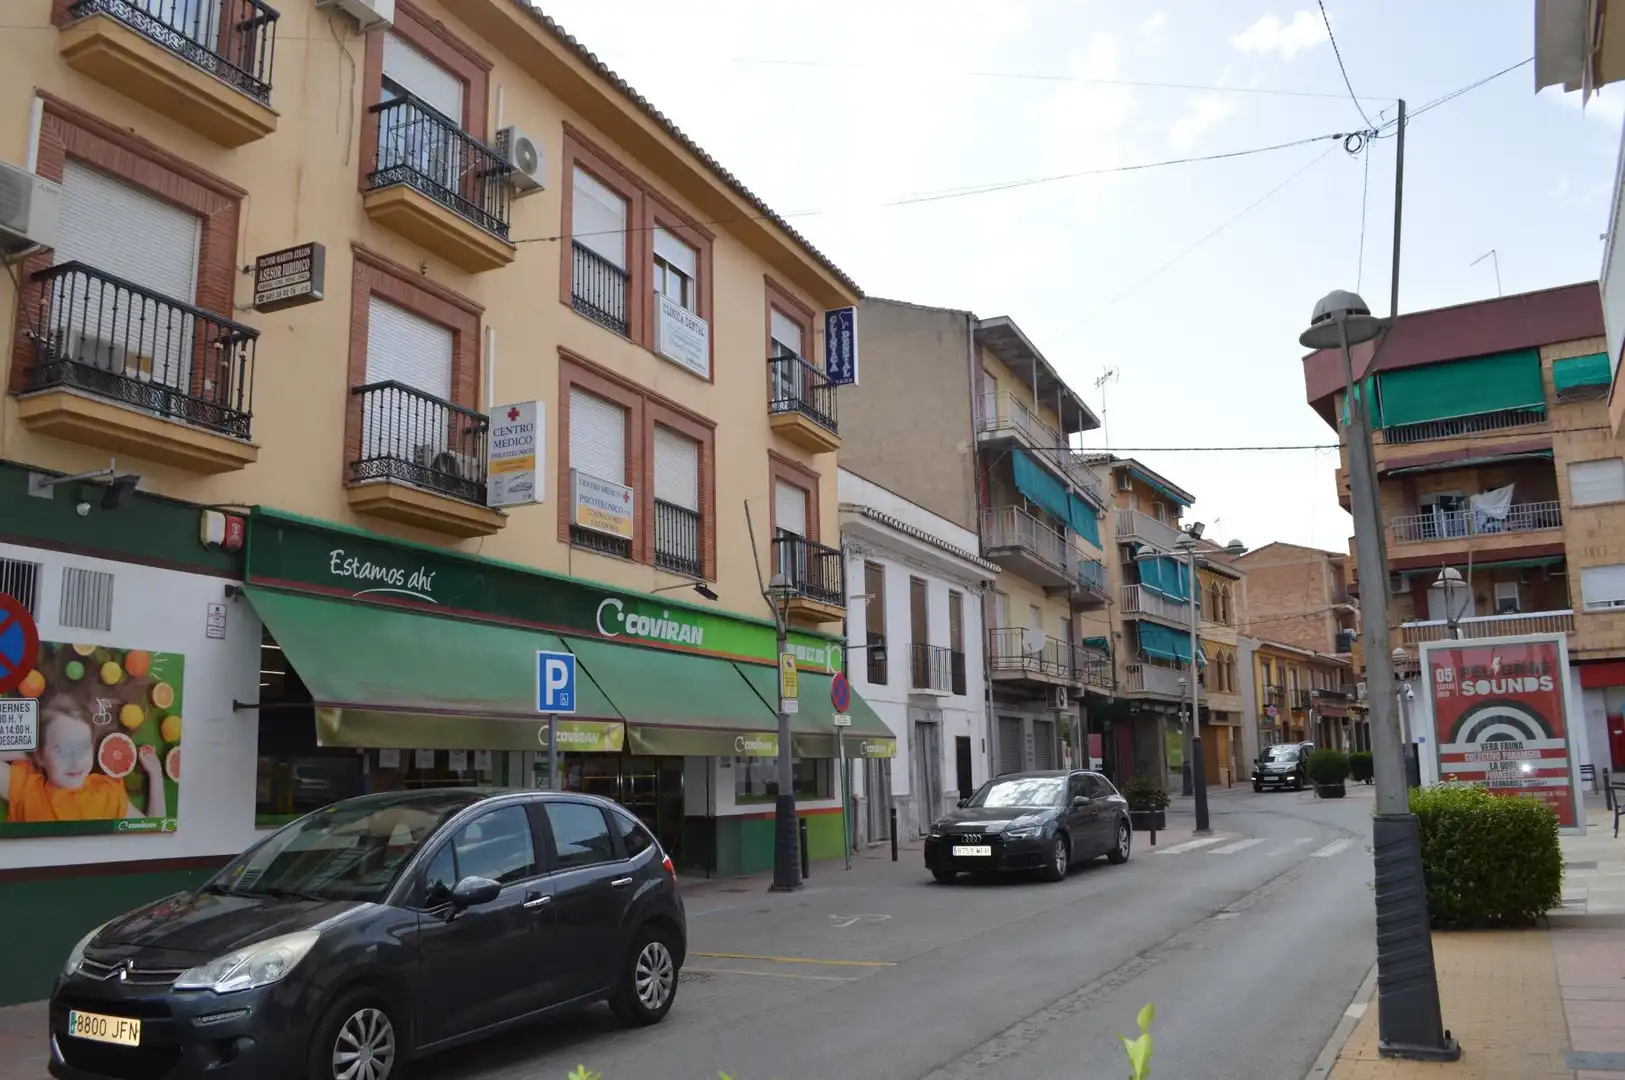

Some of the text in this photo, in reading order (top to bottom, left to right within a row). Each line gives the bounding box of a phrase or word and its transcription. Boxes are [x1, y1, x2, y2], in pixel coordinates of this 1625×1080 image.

[685, 318, 705, 337] DENTAL
[493, 422, 534, 437] CENTRO
[330, 549, 436, 591] Estamos ahí
[545, 659, 568, 705] P
[1436, 668, 1554, 696] 05 SOUNDS
[1480, 741, 1524, 751] VERA FAUNA
[77, 1014, 138, 1041] 8800 JFN
